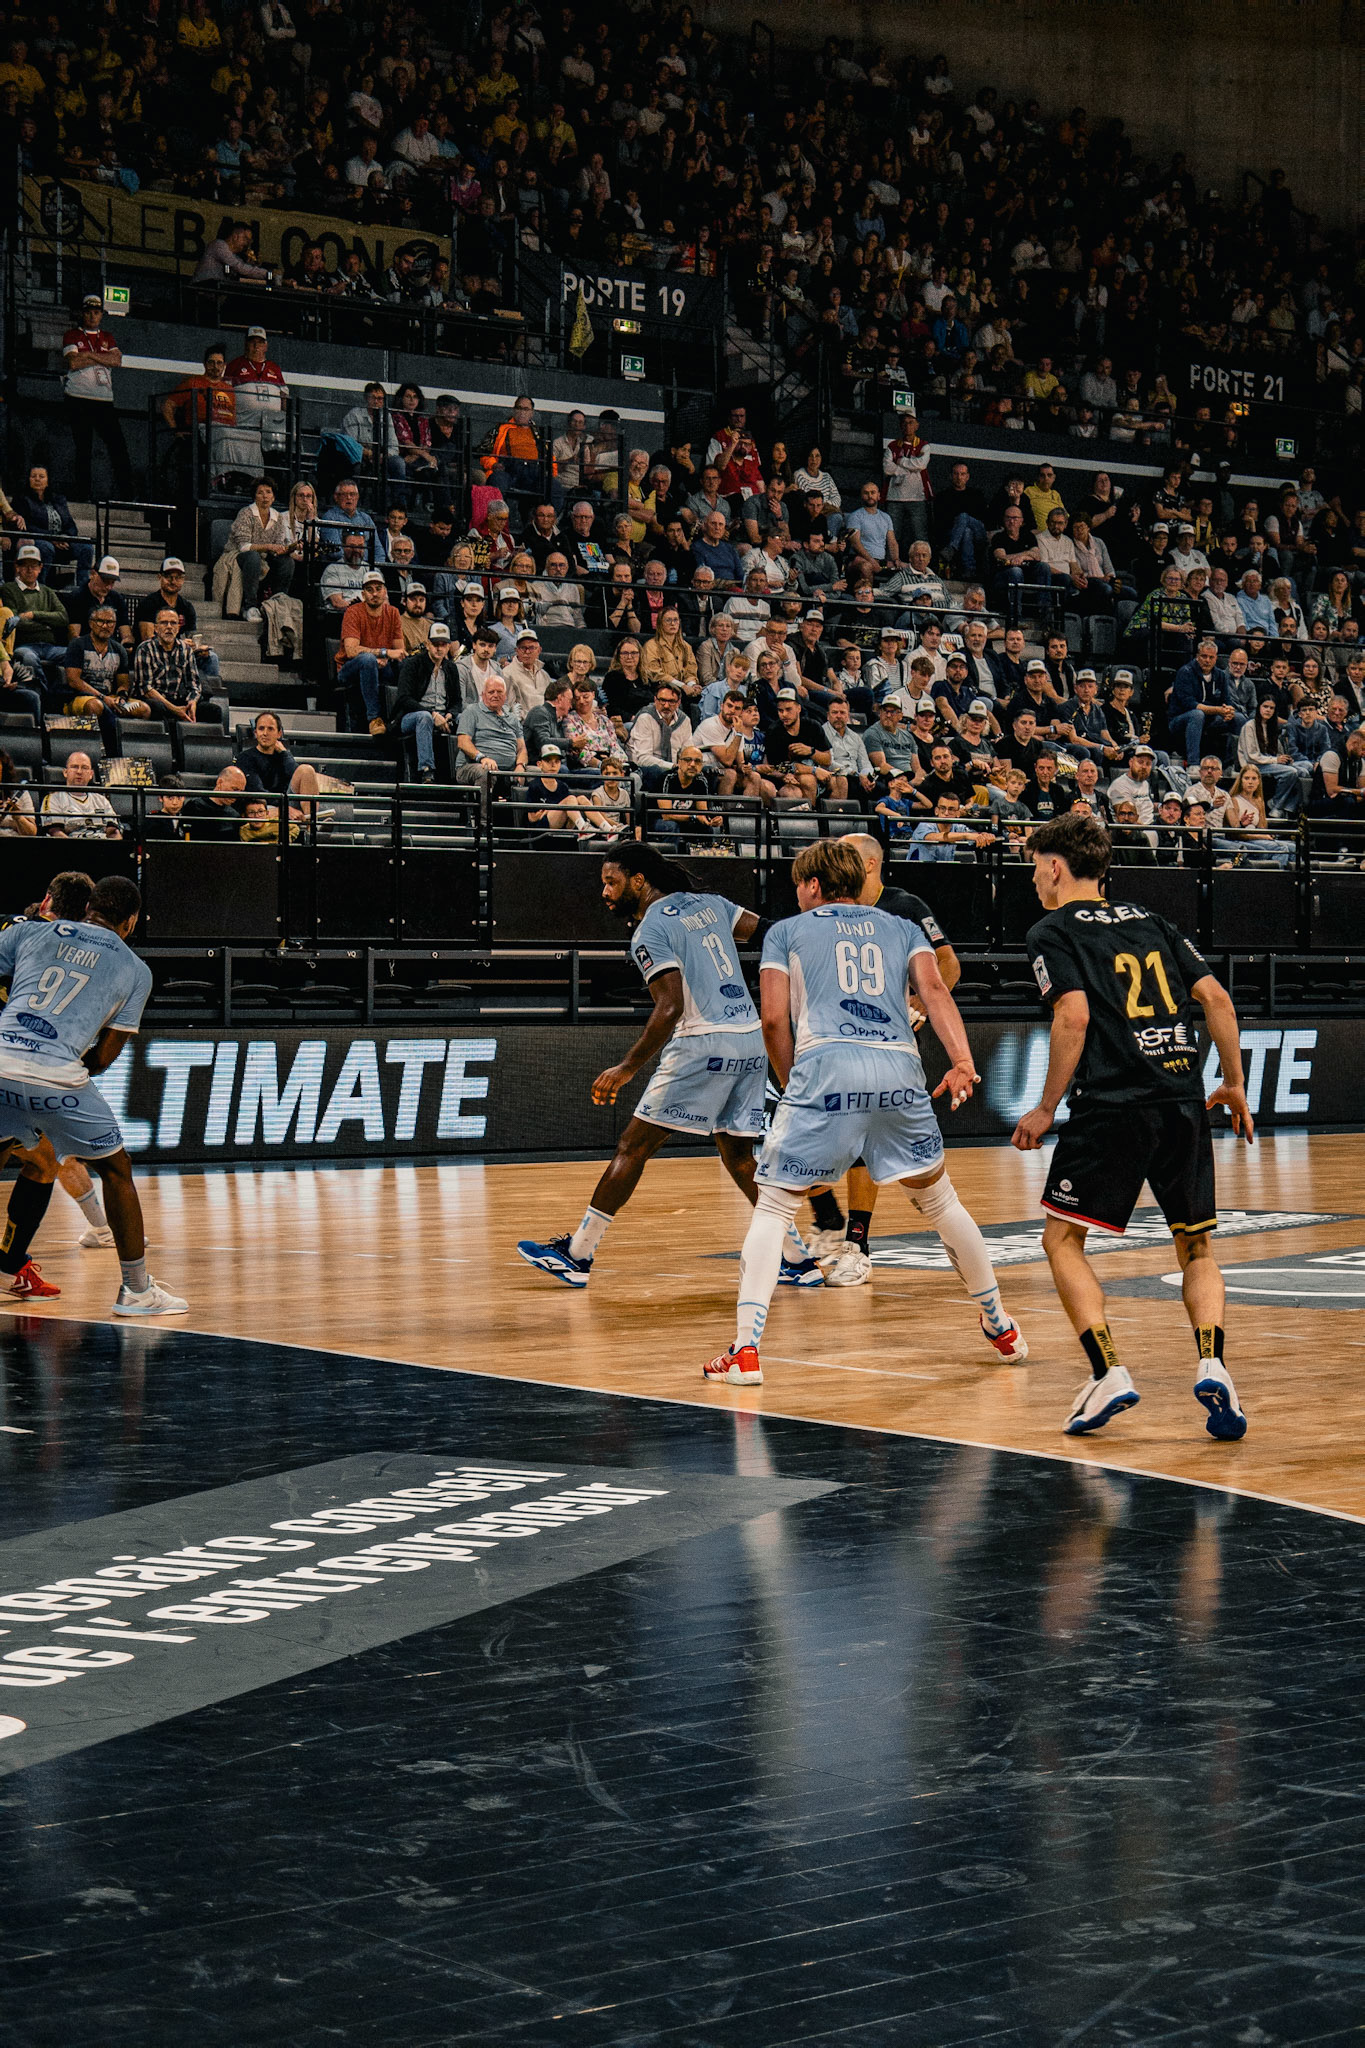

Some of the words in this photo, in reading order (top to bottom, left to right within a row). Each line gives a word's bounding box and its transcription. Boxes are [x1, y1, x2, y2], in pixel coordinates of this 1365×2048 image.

[563, 271, 646, 313] PORTE
[658, 285, 686, 317] 19
[1189, 363, 1256, 398] PORTE
[1263, 374, 1285, 402] 21
[78, 936, 120, 953] METROPOLE
[835, 920, 876, 937] JUND
[56, 942, 101, 969] VERIN
[701, 931, 735, 981] 13
[835, 939, 886, 997] 69
[28, 965, 92, 1016] 97
[1114, 950, 1178, 1019] 21
[29, 1095, 80, 1111] ECO
[94, 1038, 498, 1152] LTIMATE
[847, 1092, 875, 1110] FIT
[879, 1088, 915, 1109] ECO
[269, 1466, 568, 1535] conseil
